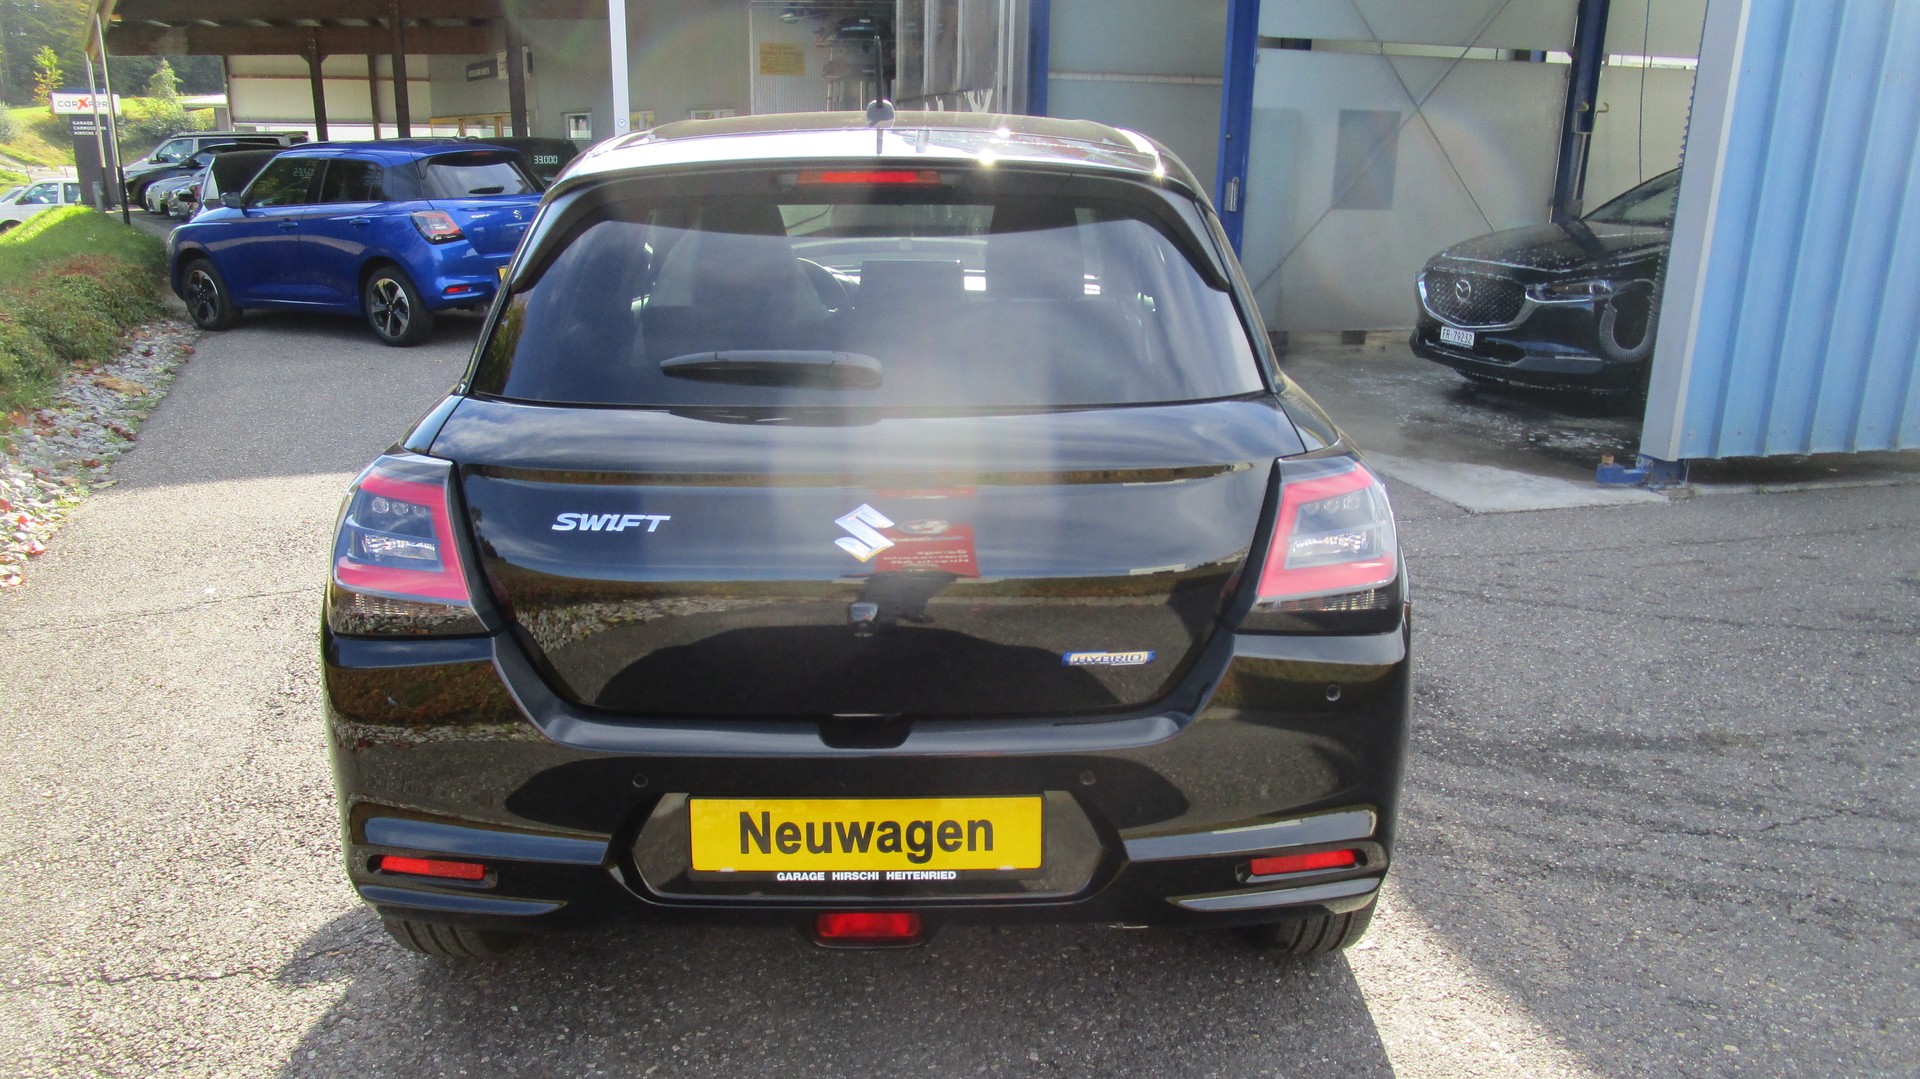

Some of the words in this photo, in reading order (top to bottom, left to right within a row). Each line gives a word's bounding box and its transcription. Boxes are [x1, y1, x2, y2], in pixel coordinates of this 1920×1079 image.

[534, 155, 558, 165] 33.000
[551, 512, 671, 532] SWIFT
[1075, 654, 1142, 665] HYBRID
[739, 811, 994, 864] Neuwagen
[777, 871, 825, 881] GARAGE
[832, 871, 880, 881] HIRSCHI
[886, 870, 957, 880] HEITENRIED
